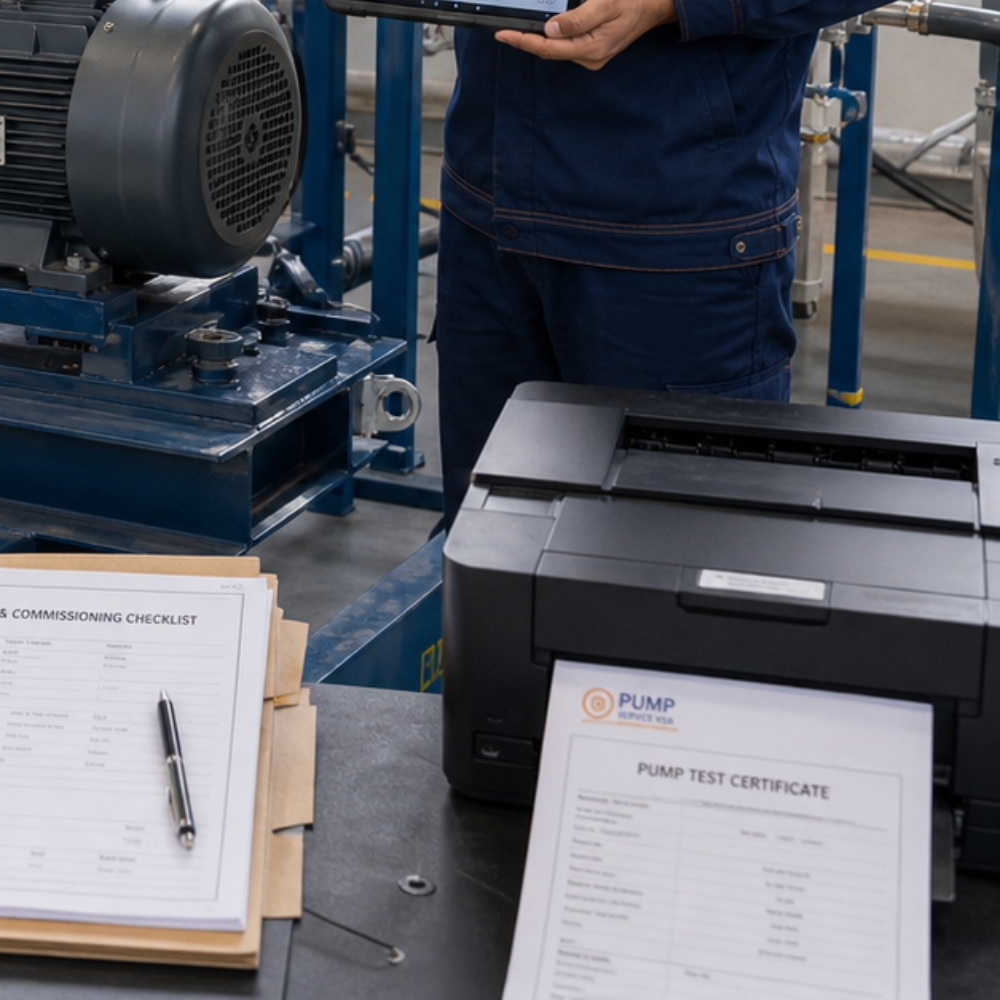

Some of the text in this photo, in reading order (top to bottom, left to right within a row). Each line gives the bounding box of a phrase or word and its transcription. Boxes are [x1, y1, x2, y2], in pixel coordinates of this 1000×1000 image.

[12, 608, 122, 624] COMMISSIONING
[126, 613, 198, 626] CHECKLIST
[618, 692, 675, 713] PUMP
[637, 762, 831, 800] PUMP TEST CERTIFICATE
